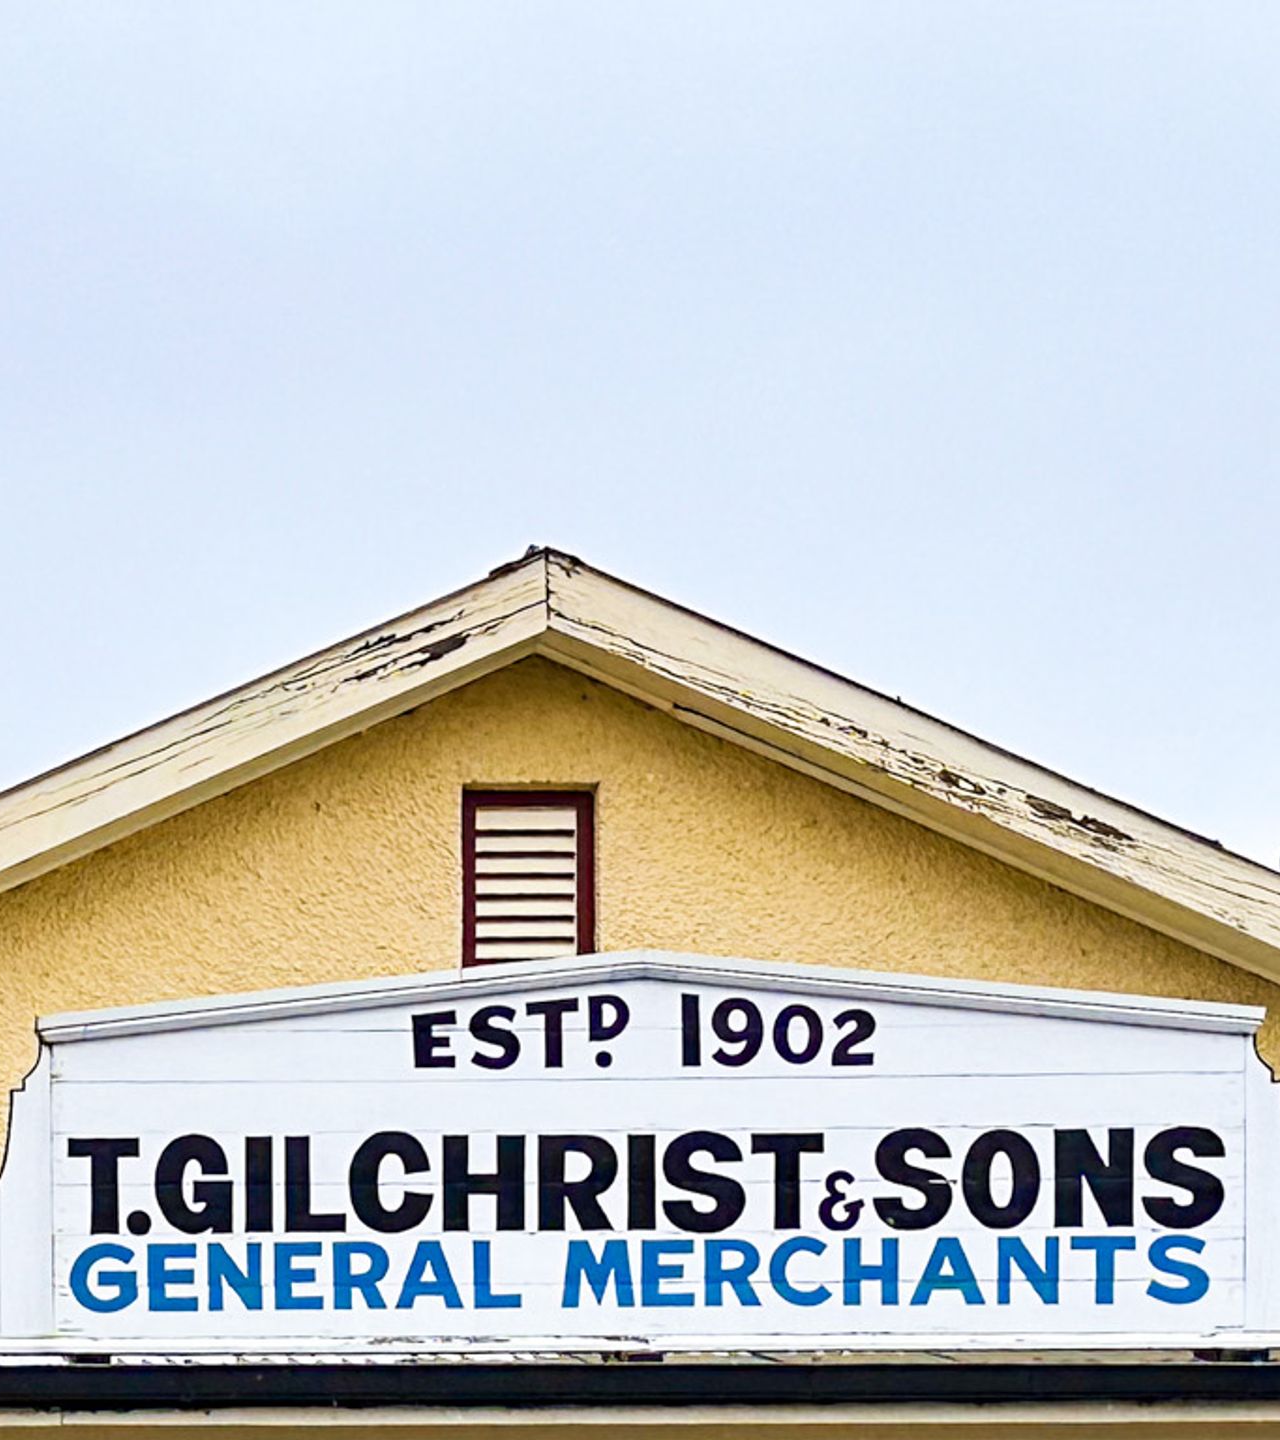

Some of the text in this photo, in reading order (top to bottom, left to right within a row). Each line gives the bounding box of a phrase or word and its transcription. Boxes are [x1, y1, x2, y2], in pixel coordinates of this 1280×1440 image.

[681, 993, 877, 1068] 1902
[69, 1234, 1210, 1313] GENERAL MERCHANTS
